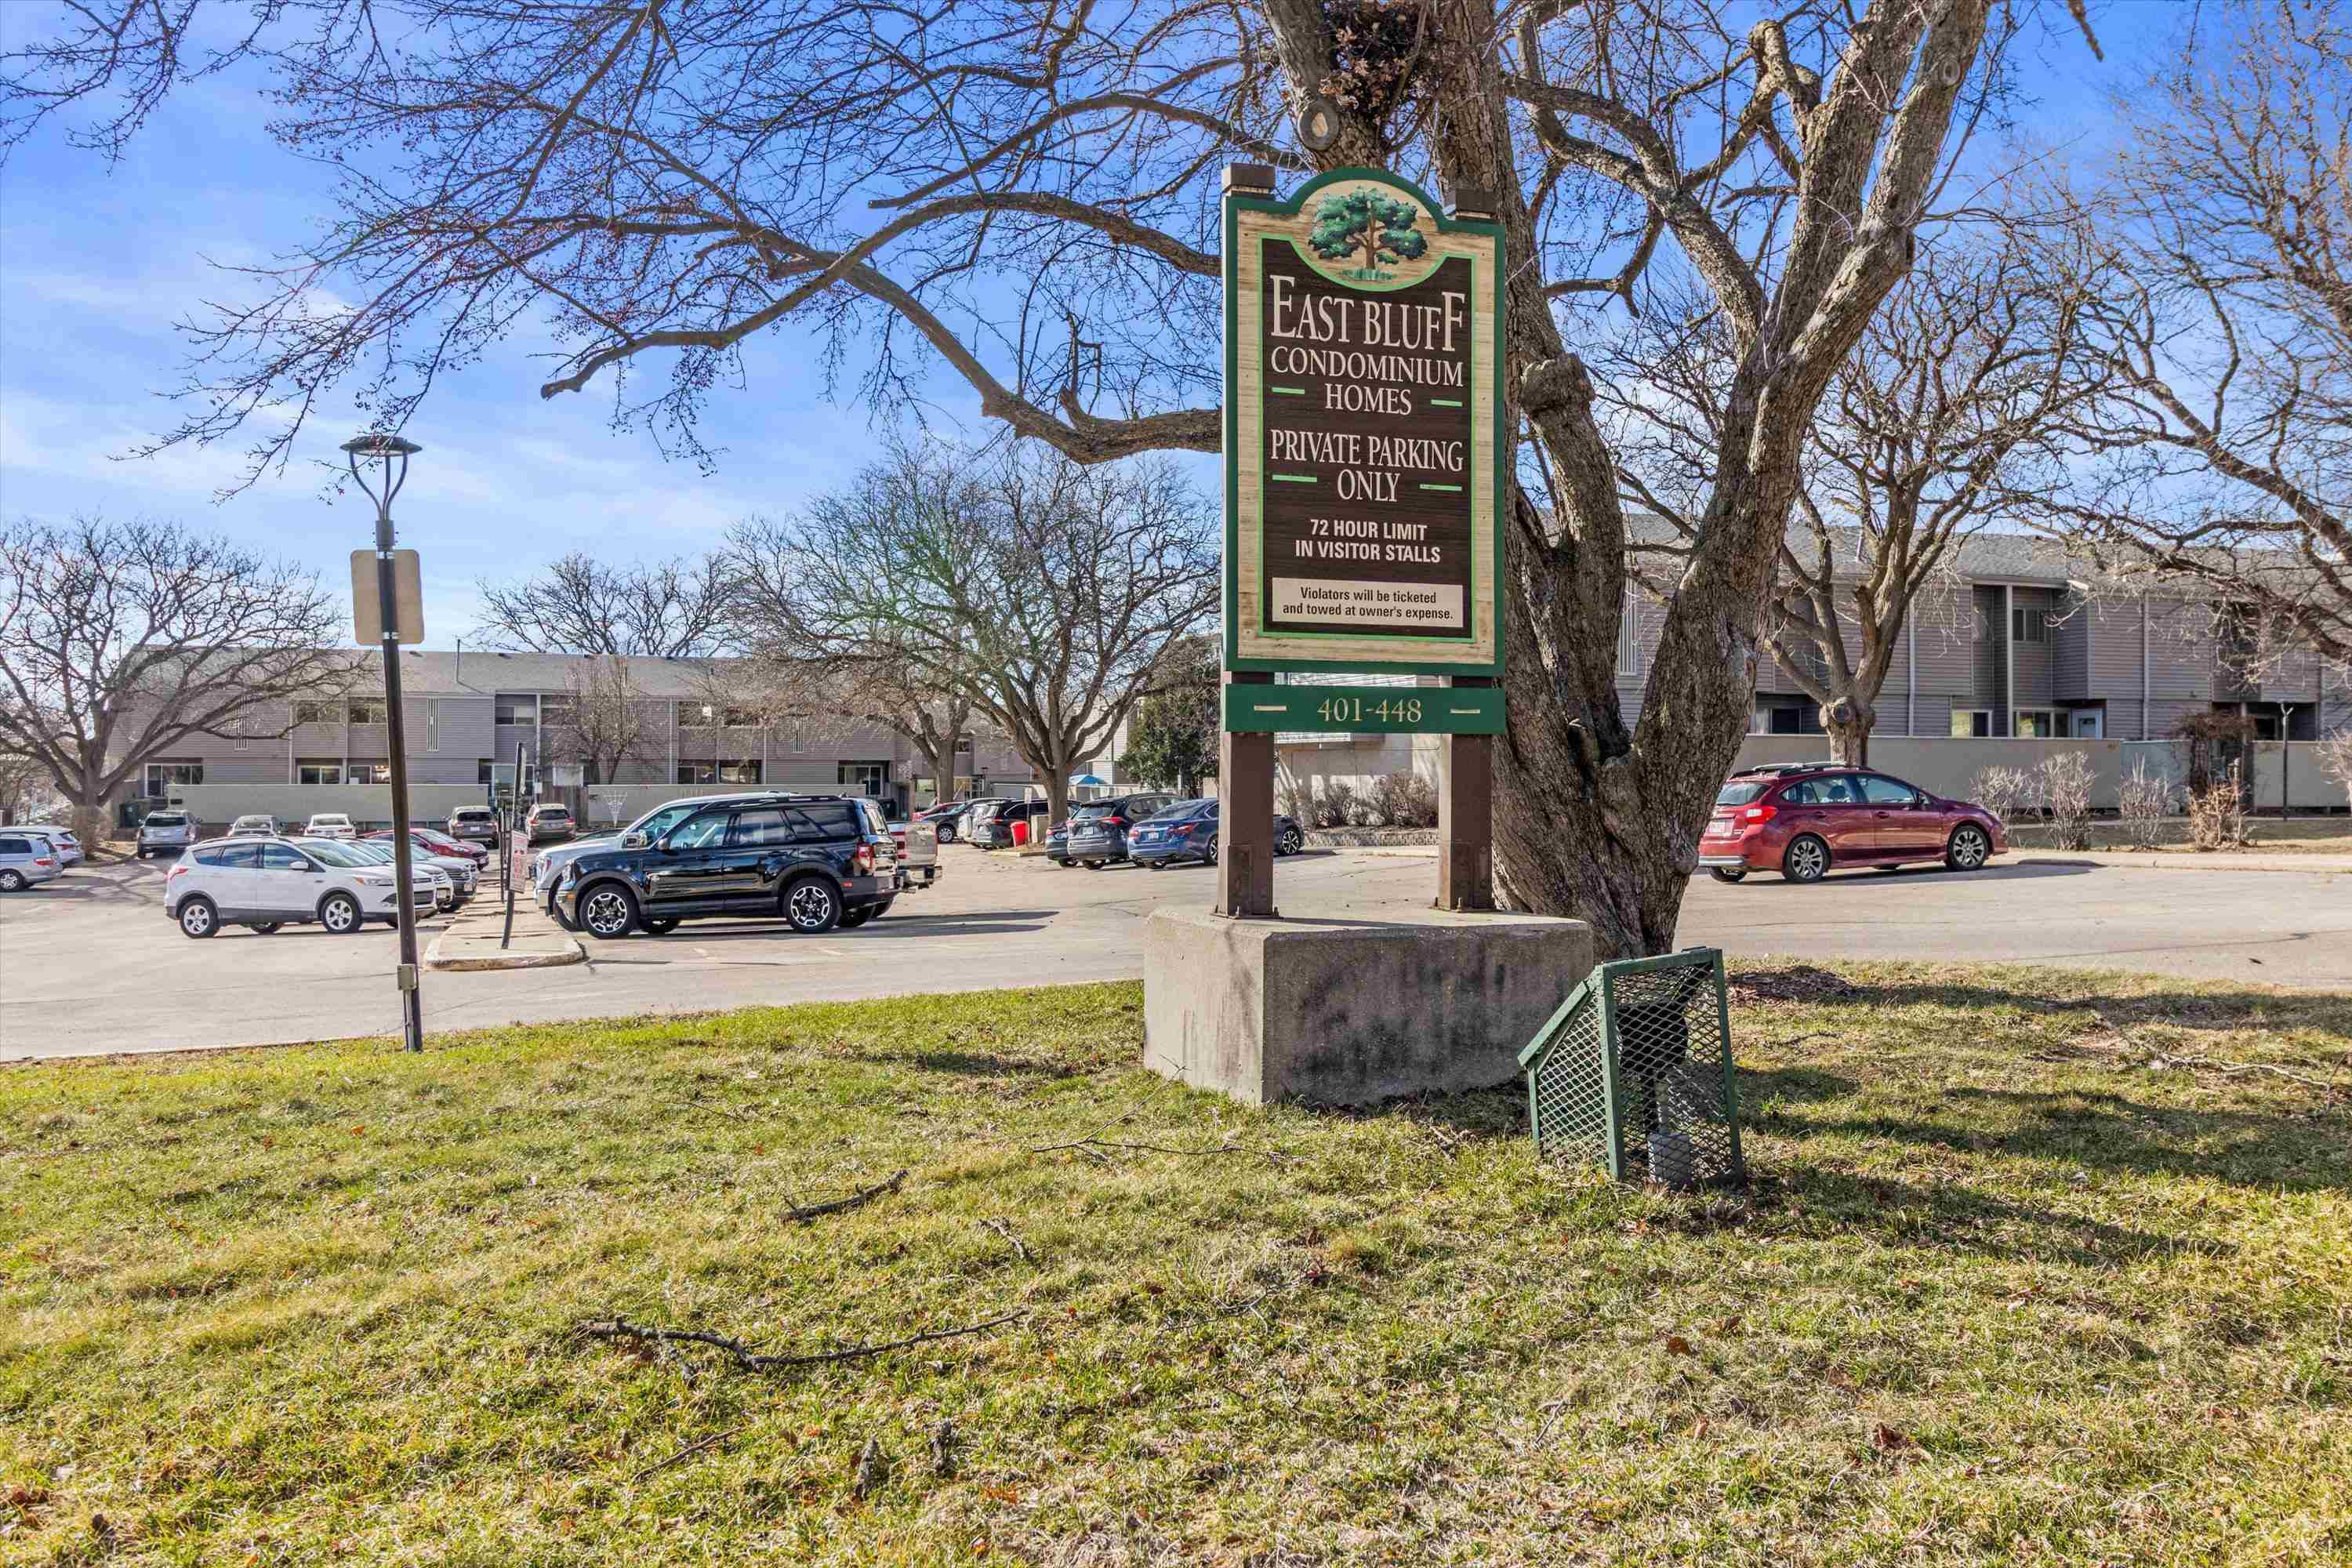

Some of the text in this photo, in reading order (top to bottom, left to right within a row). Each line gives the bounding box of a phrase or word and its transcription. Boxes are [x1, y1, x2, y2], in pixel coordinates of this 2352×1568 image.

[1269, 274, 1466, 351] EAST BLUFF
[1271, 346, 1464, 387] CONDOMINIUM
[1325, 383, 1412, 416] HOMES
[1270, 429, 1464, 471] PRIVATE PARKING
[1337, 469, 1401, 502] ONLY
[1310, 518, 1428, 541] 72 HOUR LIMIT
[1295, 540, 1441, 563] IN VISITOR STALLS
[1300, 586, 1436, 604] Violators will be ticketed
[1283, 603, 1454, 620] and towed at owner's expense.
[1317, 697, 1422, 723] 401-448
